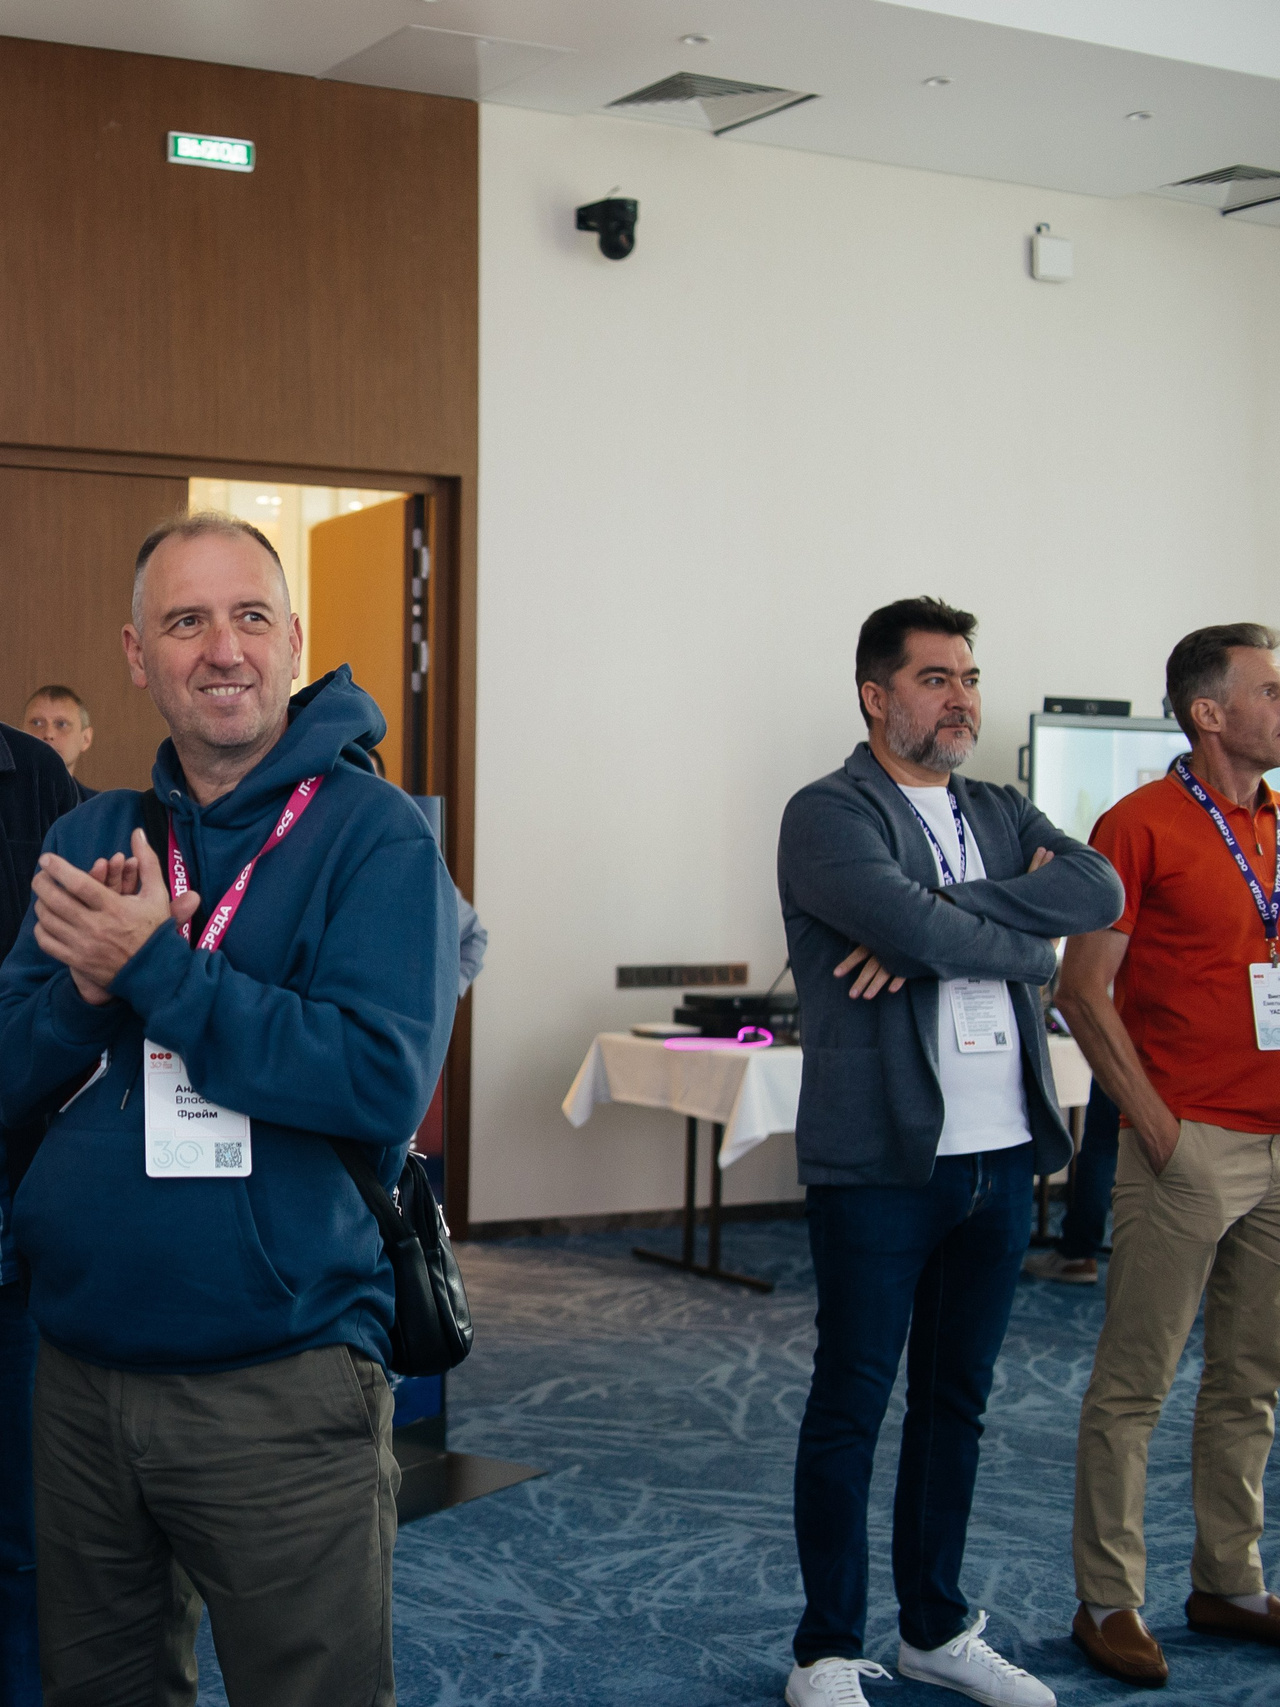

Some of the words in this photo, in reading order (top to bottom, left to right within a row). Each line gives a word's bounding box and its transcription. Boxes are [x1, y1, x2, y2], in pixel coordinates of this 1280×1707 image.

[276, 809, 294, 837] OCS
[173, 849, 188, 897] IT-СРЕД
[1235, 853, 1248, 872] OCS
[177, 1109, 218, 1120] Фрейм
